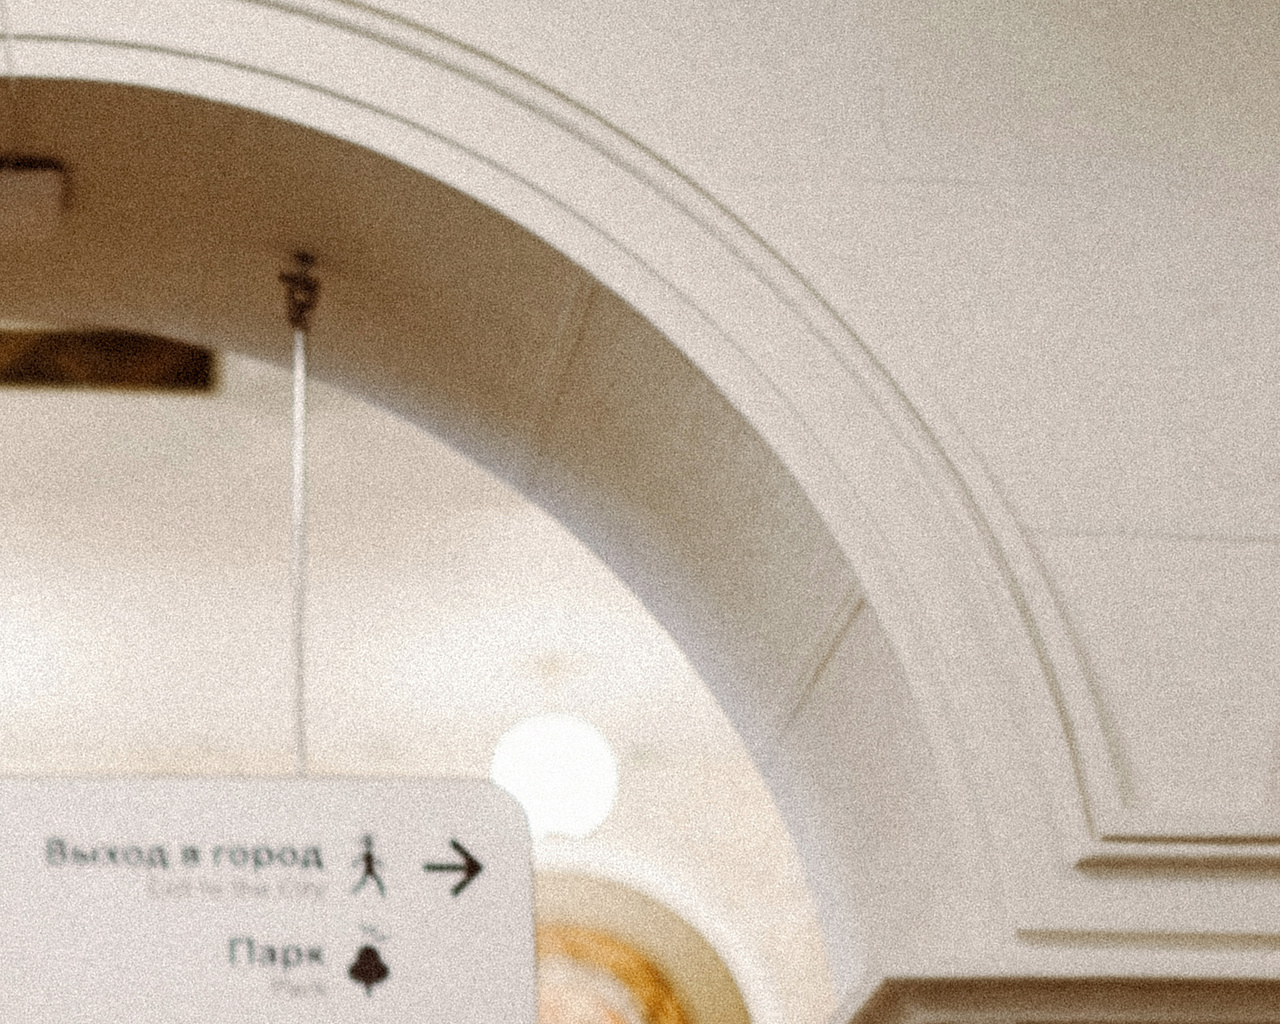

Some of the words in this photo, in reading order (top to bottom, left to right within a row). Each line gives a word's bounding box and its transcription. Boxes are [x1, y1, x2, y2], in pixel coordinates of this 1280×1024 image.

[45, 836, 170, 869] Выход
[211, 844, 324, 872] город
[228, 936, 324, 973] Парк
